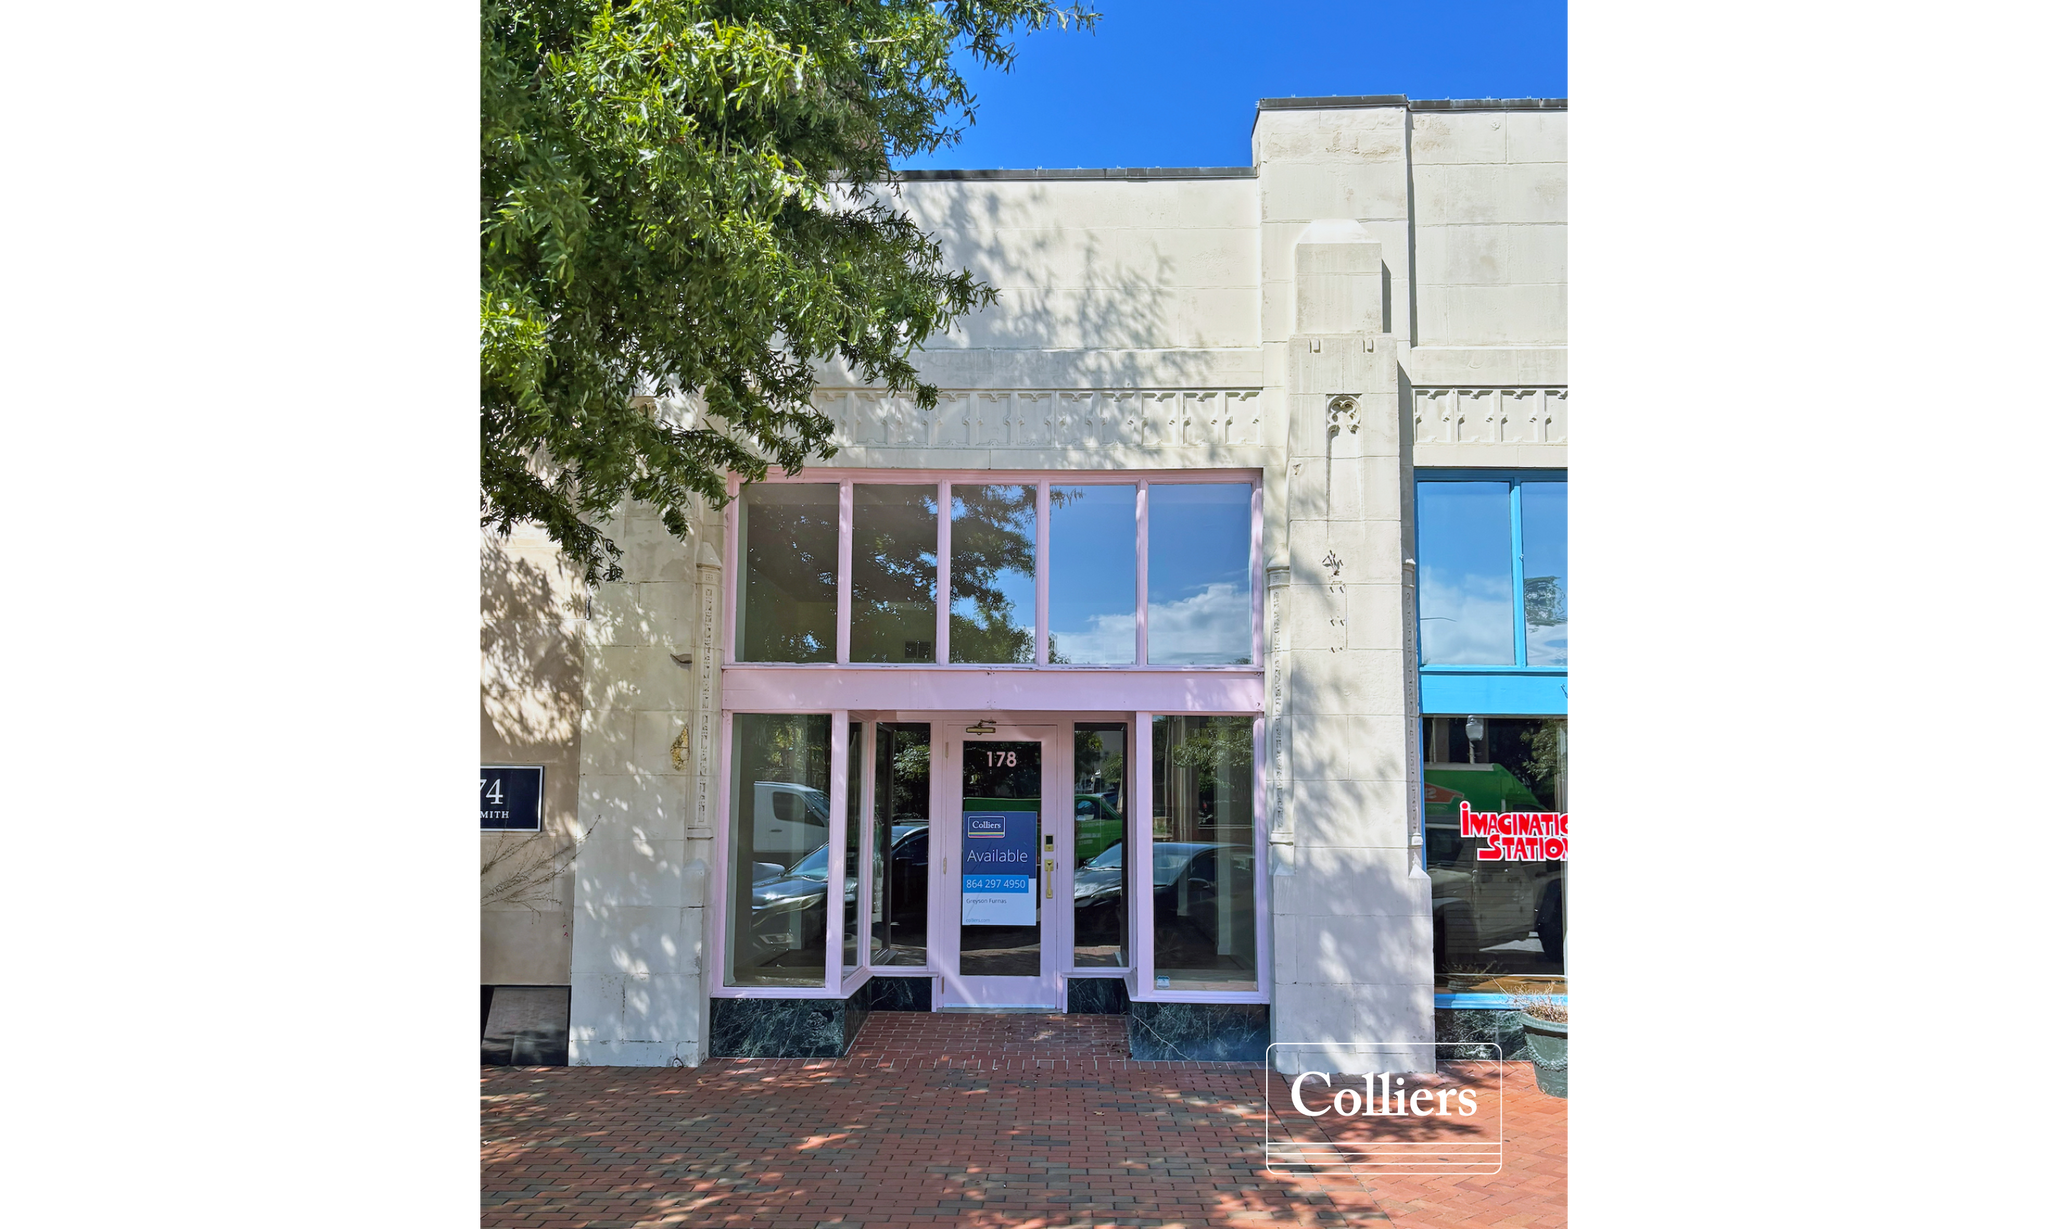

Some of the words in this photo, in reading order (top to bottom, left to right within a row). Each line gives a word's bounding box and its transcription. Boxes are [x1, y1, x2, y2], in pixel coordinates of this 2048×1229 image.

[986, 751, 1017, 767] 178
[972, 820, 1001, 829] Colliers
[966, 849, 1028, 863] Available
[966, 879, 983, 889] 864
[985, 879, 1002, 889] 297
[1003, 879, 1026, 889] 4950
